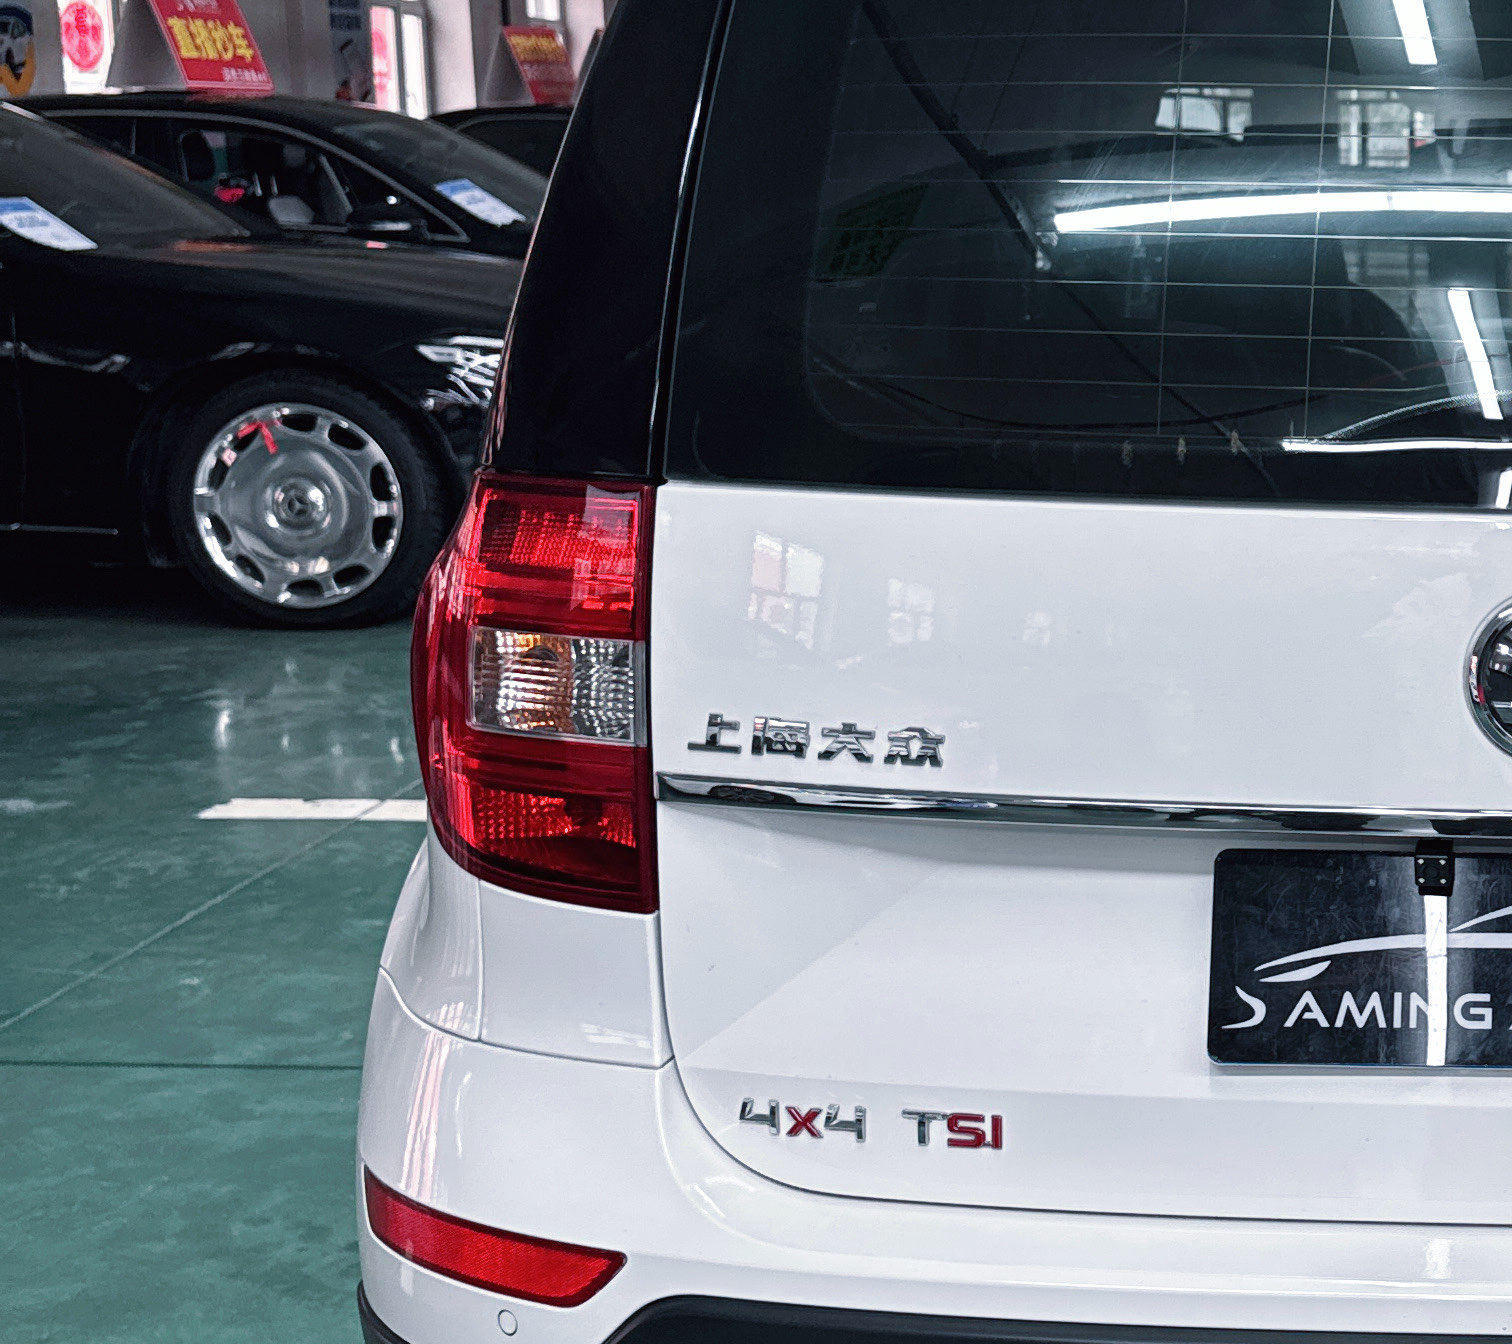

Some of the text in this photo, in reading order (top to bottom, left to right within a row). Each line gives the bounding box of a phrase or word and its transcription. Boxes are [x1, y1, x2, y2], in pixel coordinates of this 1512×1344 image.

[687, 713, 945, 767] 上海大众
[1284, 990, 1493, 1031] AMING
[901, 1108, 1003, 1150] TSI
